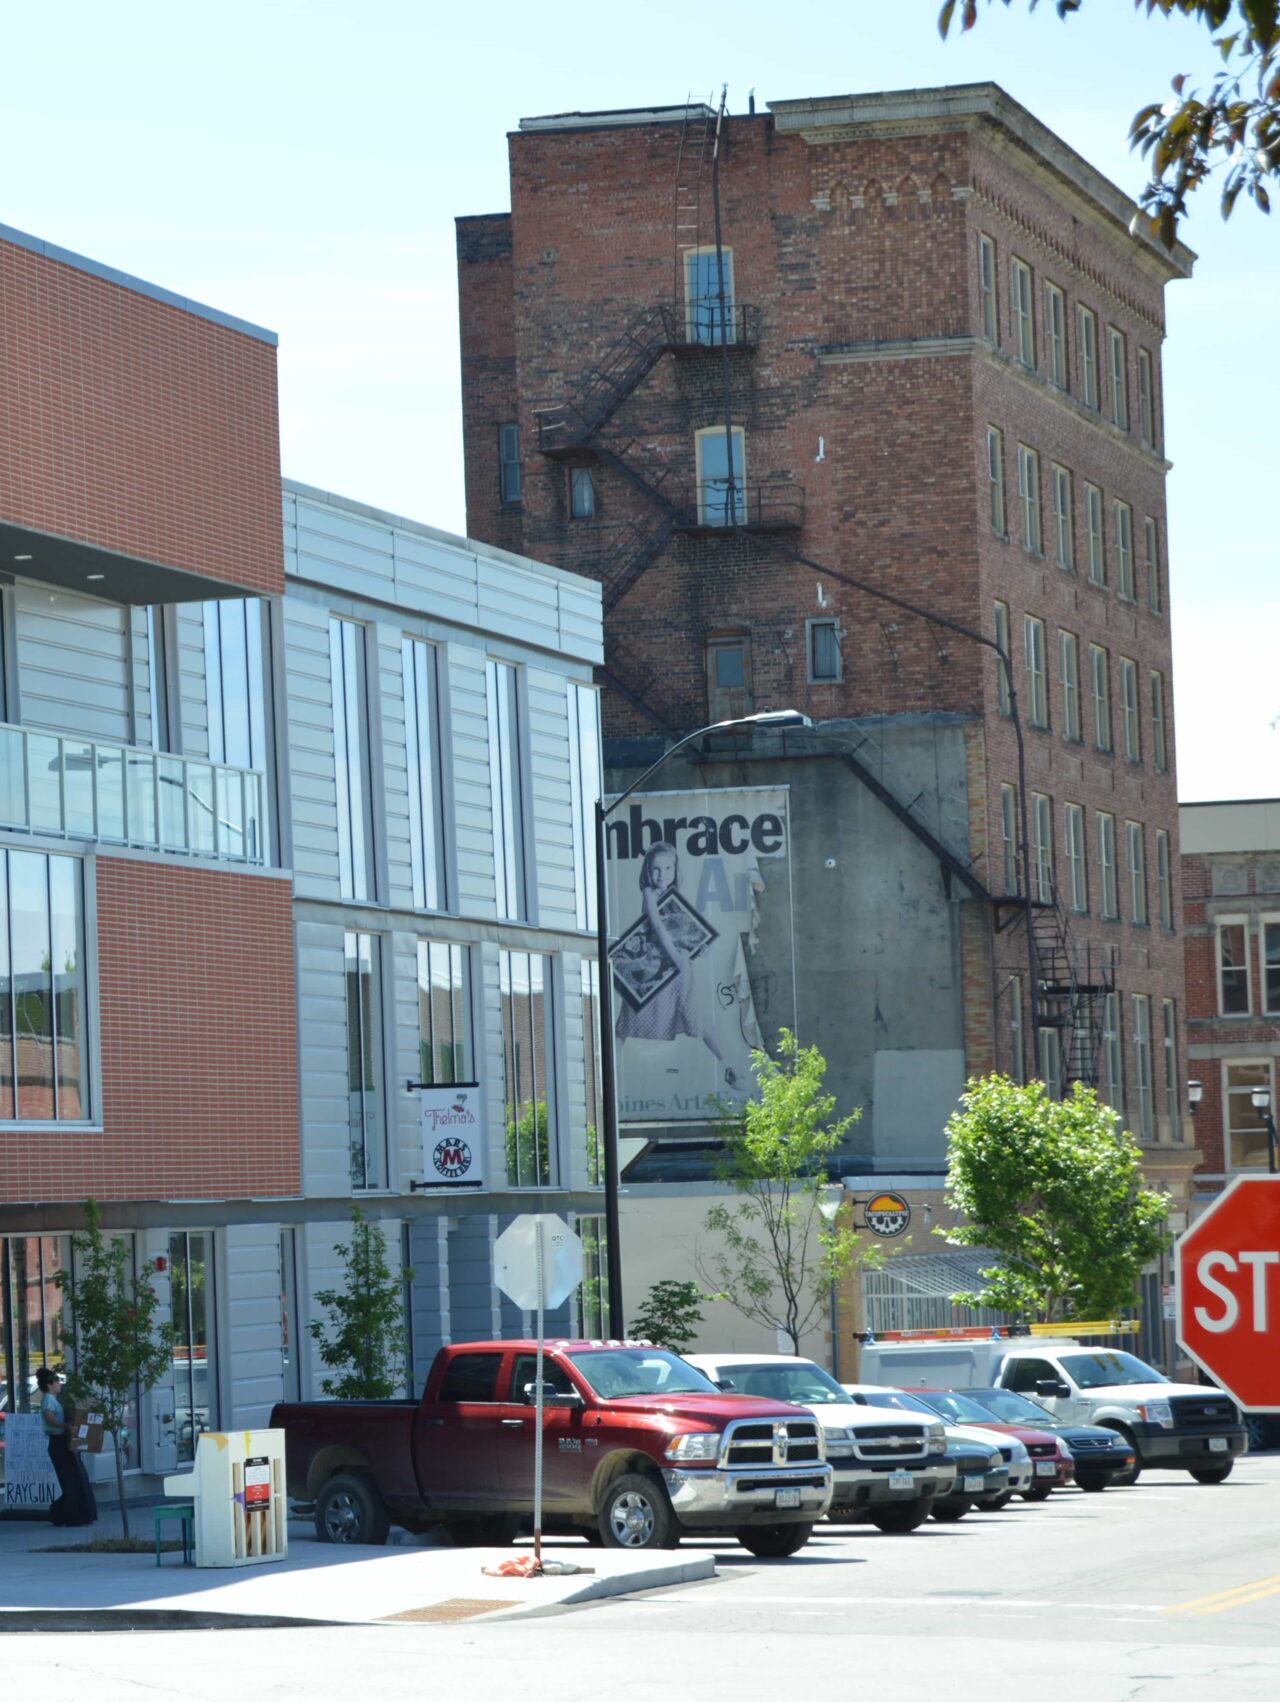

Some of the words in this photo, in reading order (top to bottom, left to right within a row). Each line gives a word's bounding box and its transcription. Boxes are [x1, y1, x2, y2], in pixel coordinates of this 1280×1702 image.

[424, 1107, 476, 1131] Thelma's
[435, 1138, 468, 1154] MARS
[1193, 1250, 1280, 1334] ST
[6, 1482, 55, 1504] RAYGUN
